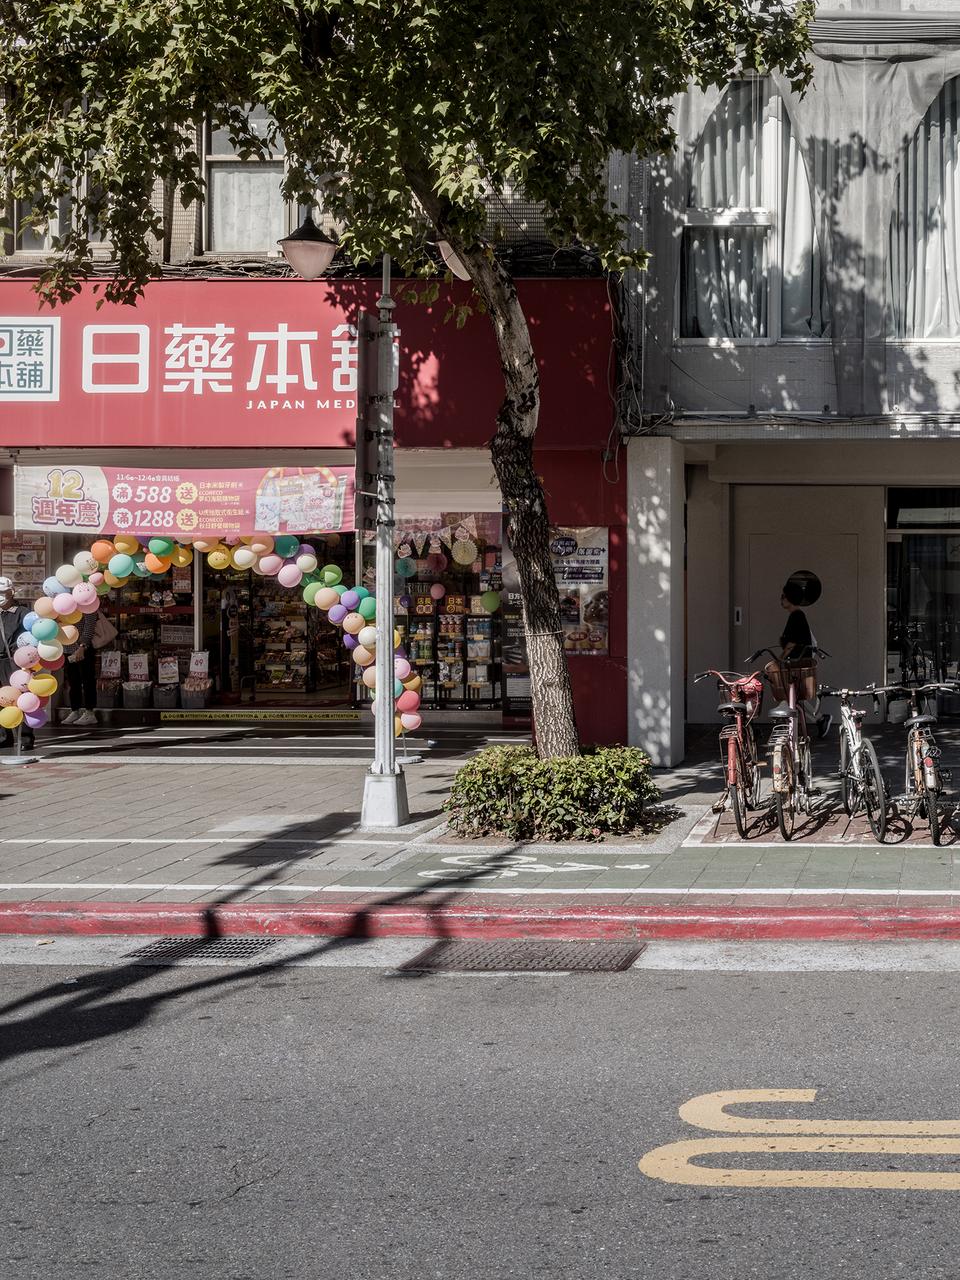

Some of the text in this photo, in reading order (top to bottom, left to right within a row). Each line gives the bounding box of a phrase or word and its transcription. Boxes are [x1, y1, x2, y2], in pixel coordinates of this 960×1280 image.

[246, 400, 305, 410] JAPAN
[48, 469, 83, 500] 12
[134, 486, 172, 503] 588
[33, 498, 99, 525] 週年慶
[134, 509, 174, 527] 1288
